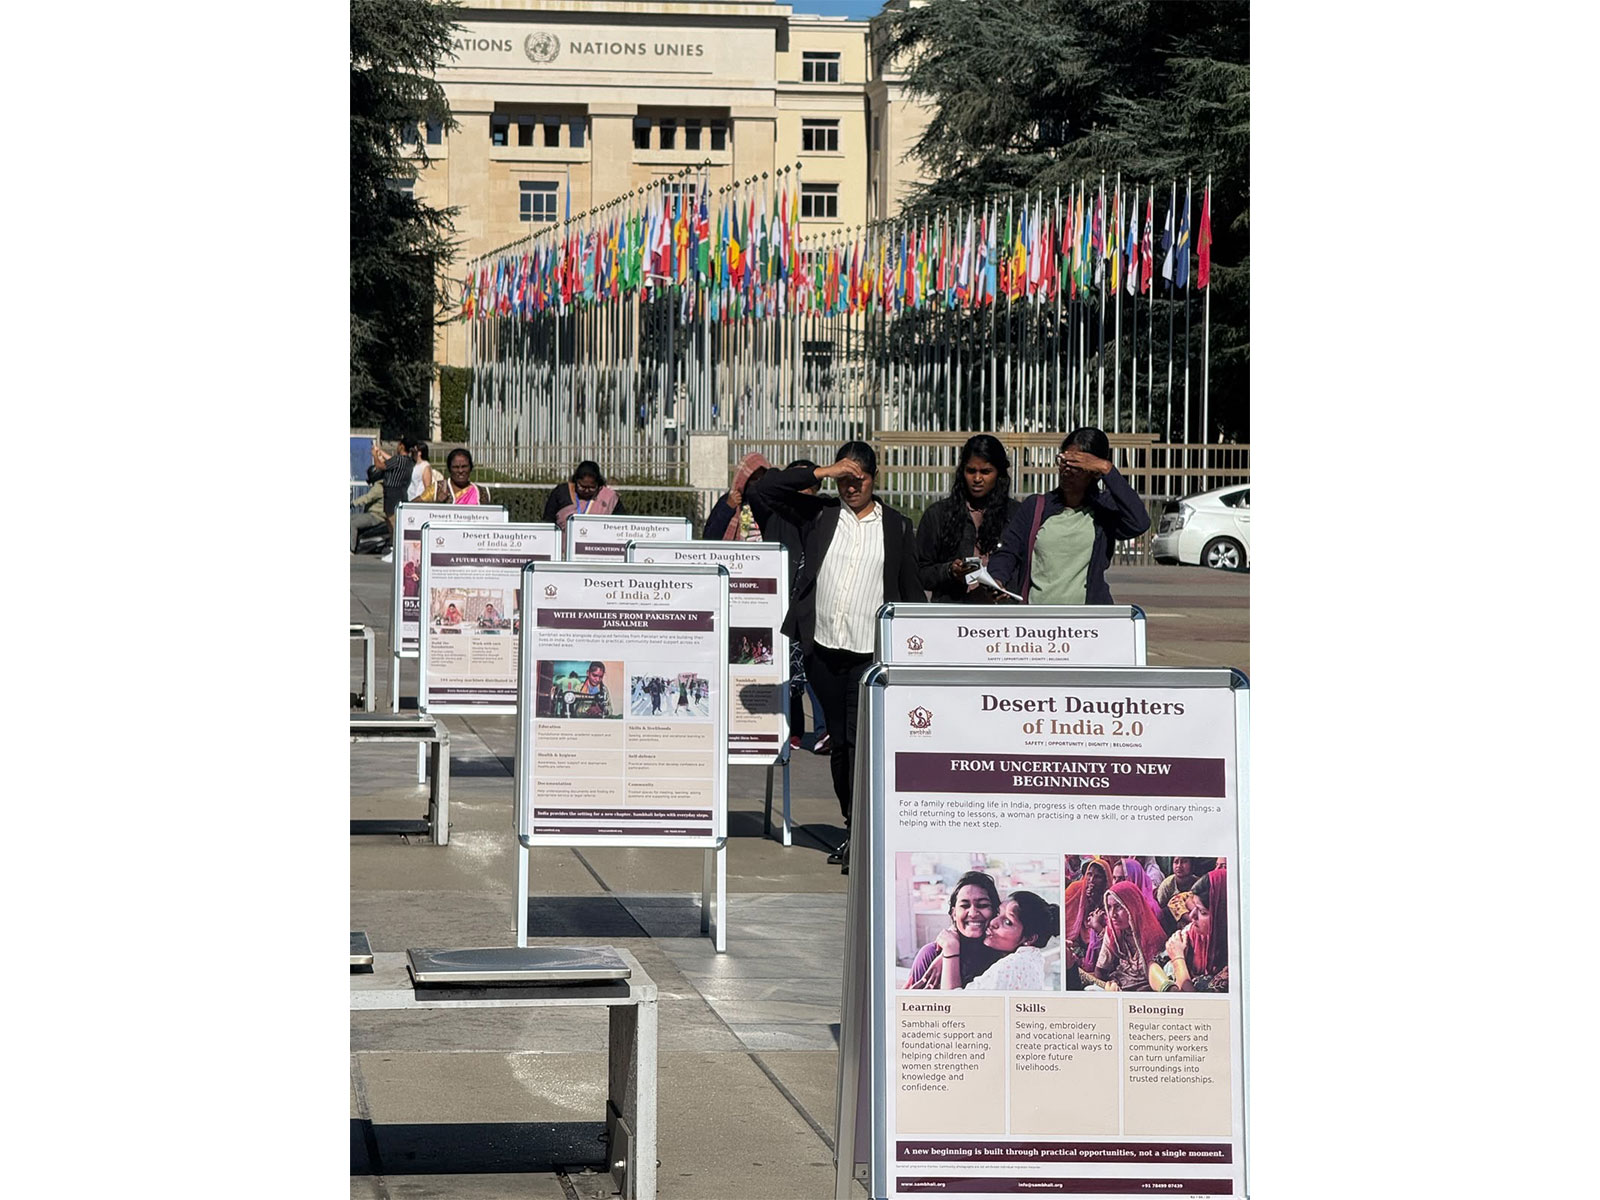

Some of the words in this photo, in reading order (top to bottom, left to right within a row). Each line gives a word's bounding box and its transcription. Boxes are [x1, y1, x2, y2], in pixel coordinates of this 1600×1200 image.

[446, 39, 512, 52] ATIONS
[570, 42, 646, 56] NATIONS
[654, 43, 703, 57] UNIES
[630, 524, 670, 533] Daughters
[493, 532, 537, 541] Daughters
[675, 552, 706, 560] Desert
[710, 552, 760, 562] Daughters
[584, 578, 623, 588] Desert
[629, 578, 693, 592] Daughters
[605, 591, 616, 599] of
[621, 591, 649, 600] India
[653, 590, 671, 600] 2.0
[602, 620, 649, 628] JAISALMER
[958, 626, 1010, 638] Desert
[1016, 626, 1098, 641] Daughters
[986, 642, 1001, 653] of
[1006, 642, 1043, 653] India
[1048, 642, 1070, 653] 2.0
[981, 694, 1057, 713] Desert
[1065, 696, 1184, 718] Daughters
[1023, 718, 1045, 734] of
[1050, 719, 1104, 736] India
[1112, 720, 1143, 736] 2.0
[951, 760, 995, 772] FROM
[1000, 760, 1107, 774] UNCERTAINTY
[1110, 763, 1132, 774] TO
[1136, 763, 1171, 775] NEW
[1013, 775, 1110, 788] BEGINNINGS
[921, 800, 945, 808] family
[947, 800, 985, 809] rebuilding
[1122, 804, 1152, 812] through
[1154, 804, 1186, 813] ordinary
[1188, 803, 1214, 813] things:
[920, 810, 956, 818] returning
[1037, 812, 1075, 821] practising
[899, 819, 928, 828] helping
[902, 1002, 951, 1014] Learning
[1016, 1003, 1046, 1012] Skills
[1129, 1005, 1184, 1016] Belonging
[901, 1020, 939, 1028] Sambhali
[942, 1020, 965, 1028] offers
[1015, 1021, 1047, 1031] Sewing,
[1049, 1022, 1096, 1031] embroidery
[1129, 1022, 1160, 1032] Regular
[943, 1032, 975, 1040] support
[1033, 1031, 1075, 1040] vocational
[1077, 1032, 1111, 1042] learning
[1129, 1033, 1166, 1041] teachers,
[1168, 1034, 1193, 1042] peers
[902, 1041, 953, 1049] foundational
[955, 1041, 991, 1051] learning,
[1044, 1042, 1079, 1052] practical
[1081, 1044, 1102, 1052] ways
[1129, 1044, 1174, 1053] community
[902, 1052, 933, 1061] helping
[1015, 1053, 1046, 1062] explore
[1165, 1054, 1205, 1062] unfamiliar
[934, 1063, 979, 1072] strengthen
[1016, 1063, 1061, 1071] livelihoods.
[1129, 1064, 1182, 1074] surroundings
[902, 1073, 946, 1082] knowledge
[1160, 1075, 1214, 1085] relationships.
[931, 1148, 972, 1156] beginning
[1006, 1148, 1039, 1157] through
[1041, 1148, 1077, 1157] practical
[1079, 1149, 1136, 1158] opportunities,
[1162, 1149, 1186, 1158] single
